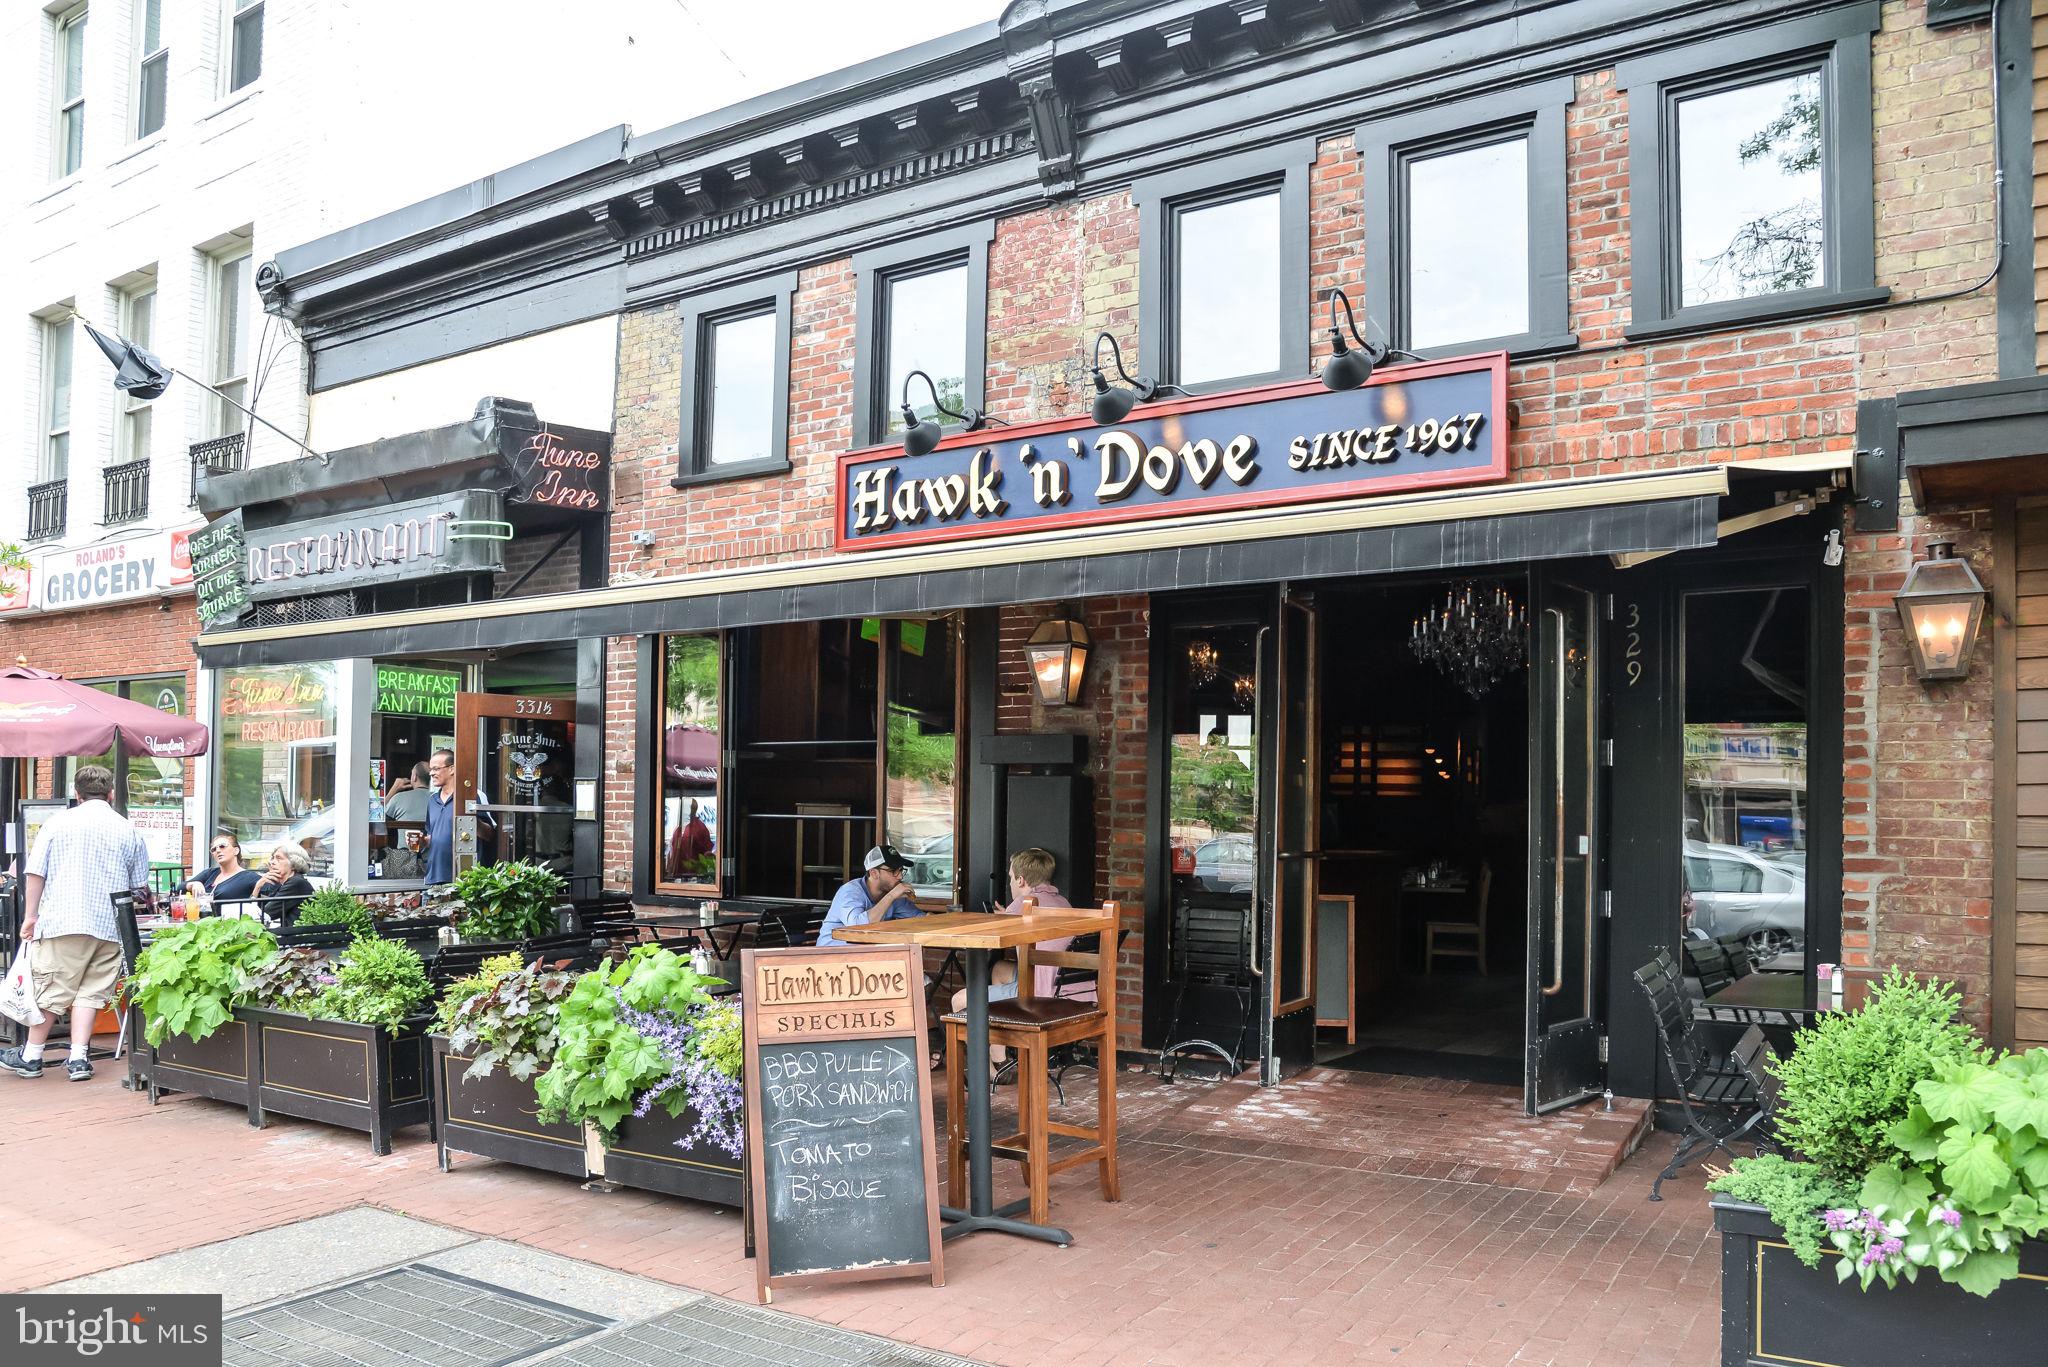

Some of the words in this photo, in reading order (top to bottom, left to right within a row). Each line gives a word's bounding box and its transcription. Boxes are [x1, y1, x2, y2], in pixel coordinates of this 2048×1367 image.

[533, 432, 600, 469] Tune
[853, 449, 1004, 531] Hawk
[1094, 430, 1258, 499] Dove
[1288, 424, 1400, 470] SINCE
[1404, 412, 1484, 456] 1967
[536, 470, 599, 508] Inn
[75, 545, 126, 567] ROLAND'S
[191, 545, 237, 576] CORNER
[249, 513, 449, 582] RESTAURANT
[47, 557, 155, 604] GROCERY
[196, 586, 245, 621] SQUARE
[241, 678, 283, 708] Tune
[285, 672, 325, 705] Inn
[378, 670, 460, 694] BREAKFAST
[378, 692, 455, 716] ANYTIME
[241, 719, 326, 742] RESTAURANT
[501, 732, 532, 746] Tune
[534, 732, 556, 748] Inn
[763, 966, 823, 1002] Hawk
[847, 965, 904, 998] Dove
[777, 1010, 896, 1033] SPECIALS
[763, 1051, 819, 1081] BBQ
[822, 1045, 912, 1077] PULLED
[767, 1083, 825, 1109] PORK
[770, 1136, 872, 1166] TOMATO
